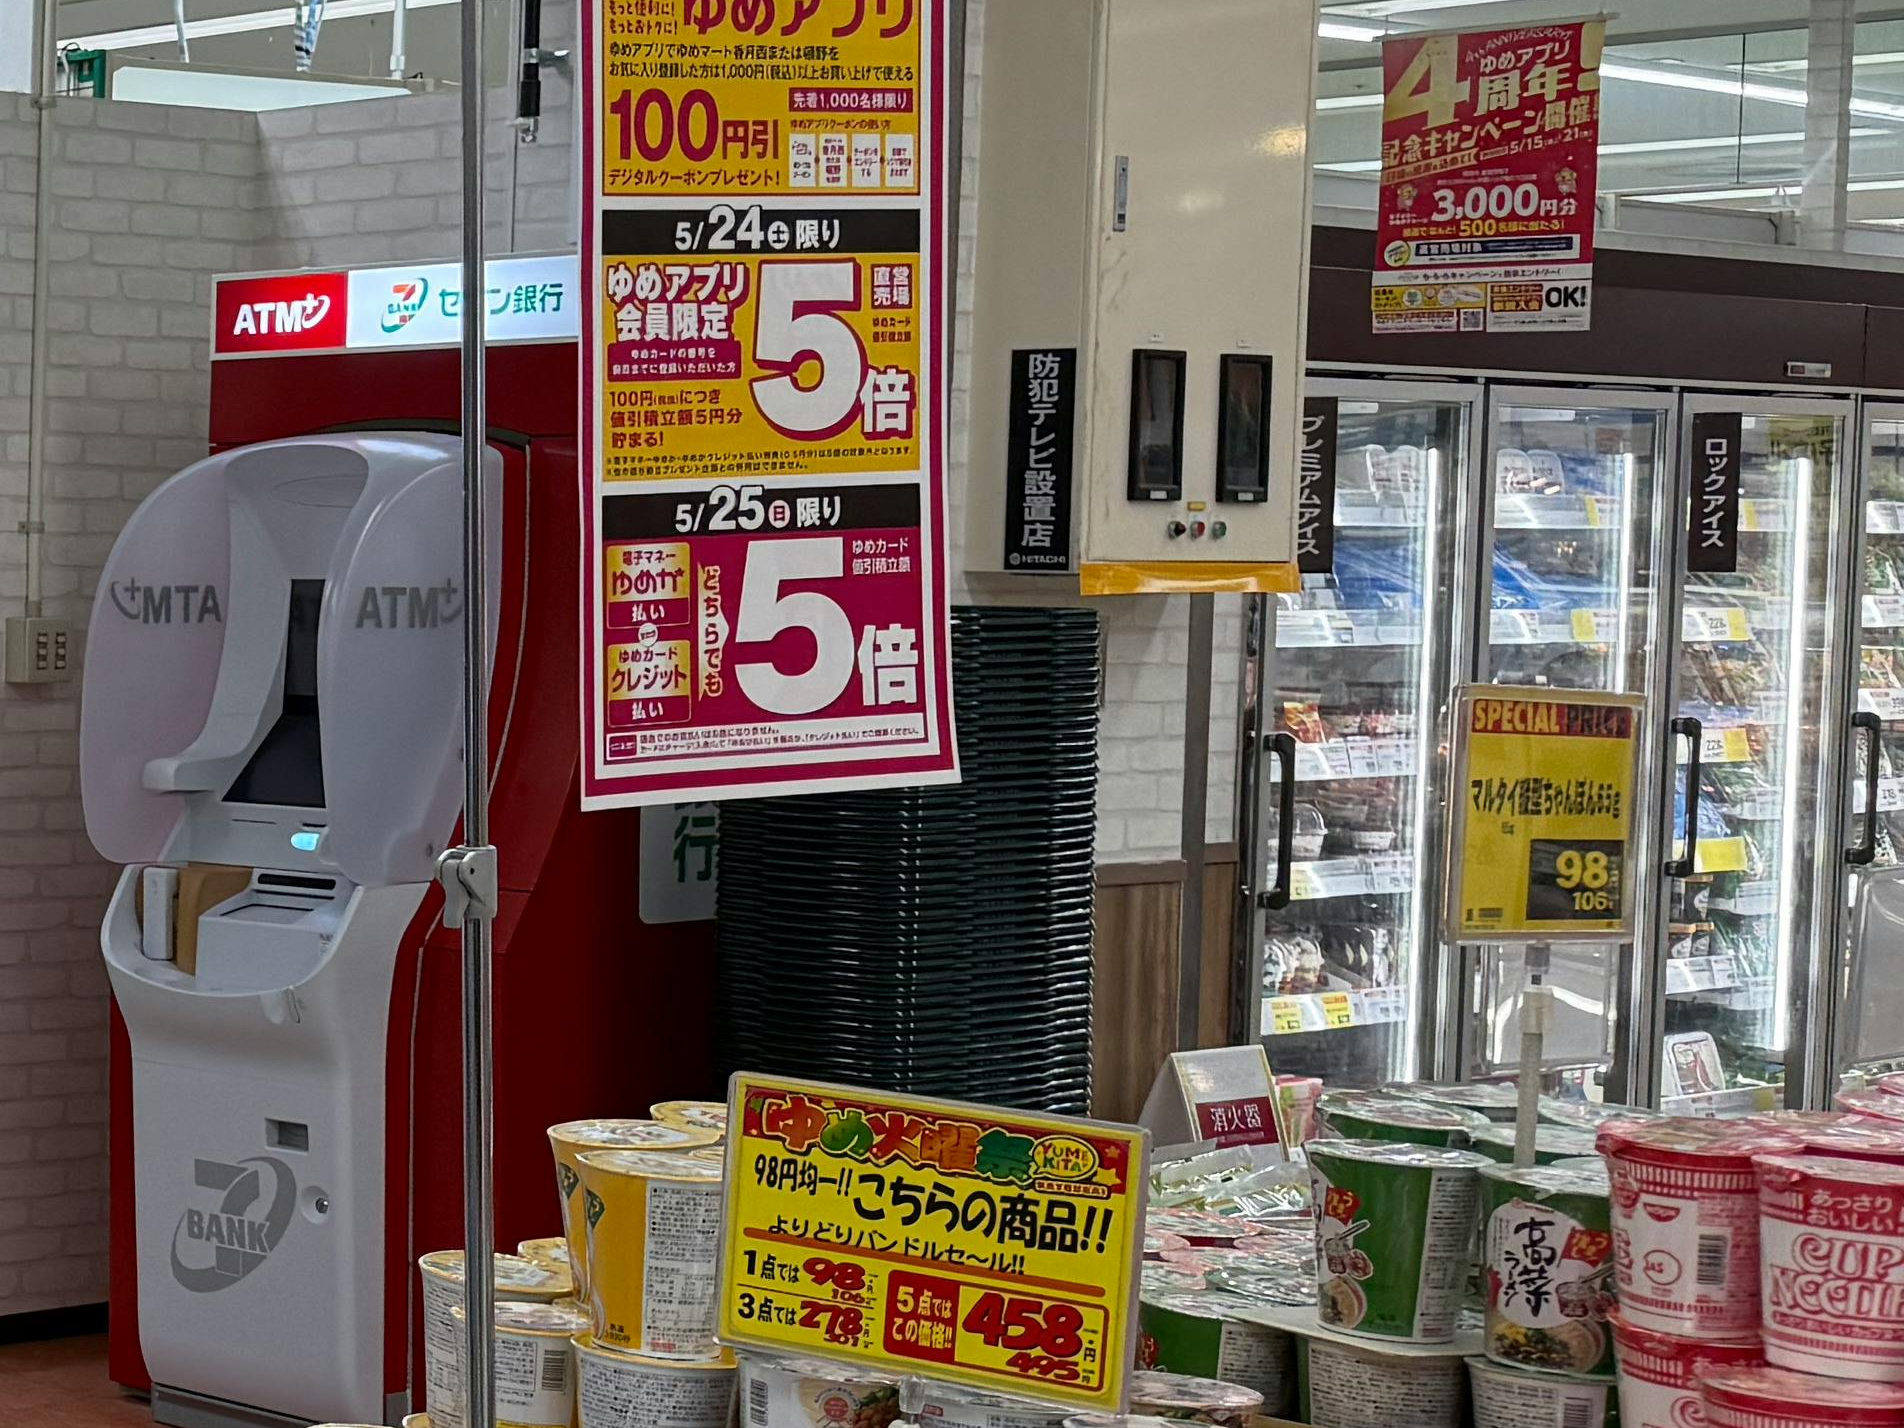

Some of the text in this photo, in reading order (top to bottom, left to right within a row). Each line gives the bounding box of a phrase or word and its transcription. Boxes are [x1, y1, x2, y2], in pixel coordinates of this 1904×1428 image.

[1479, 39, 1572, 74] ゆめアプリ
[609, 88, 780, 162] 100円引
[608, 169, 780, 188] デジタルクーポンプレゼント!
[608, 263, 746, 302] ゆめアプリ
[1545, 285, 1587, 310] OK!
[233, 301, 302, 336] ATM
[615, 302, 729, 342] 会員限定
[611, 430, 665, 449] 貯まる!
[1021, 353, 1061, 548] 防犯テレビ設置店
[1700, 436, 1728, 548] ロックアイス
[852, 537, 909, 556] ゆめカード
[356, 584, 441, 629] ATM
[631, 604, 665, 624] 払い
[701, 565, 724, 697] どちらでも
[618, 645, 679, 662] ゆめカード
[610, 663, 688, 692] クレジット
[631, 700, 664, 721] 払い
[1474, 699, 1562, 733] SPECIAL
[1556, 850, 1609, 889] 98
[1572, 891, 1608, 911] 106
[1209, 1103, 1262, 1132] 消火器
[753, 1152, 1114, 1255] 98円均一!! こちらの商品!!
[1810, 1189, 1893, 1212] あっさり
[185, 1206, 270, 1254] BANK
[742, 1249, 866, 1290] 1点では 98
[1792, 1233, 1904, 1276] CUP
[738, 1291, 864, 1336] 3点では 278
[895, 1285, 952, 1318] 5点では
[962, 1290, 1085, 1358] 458
